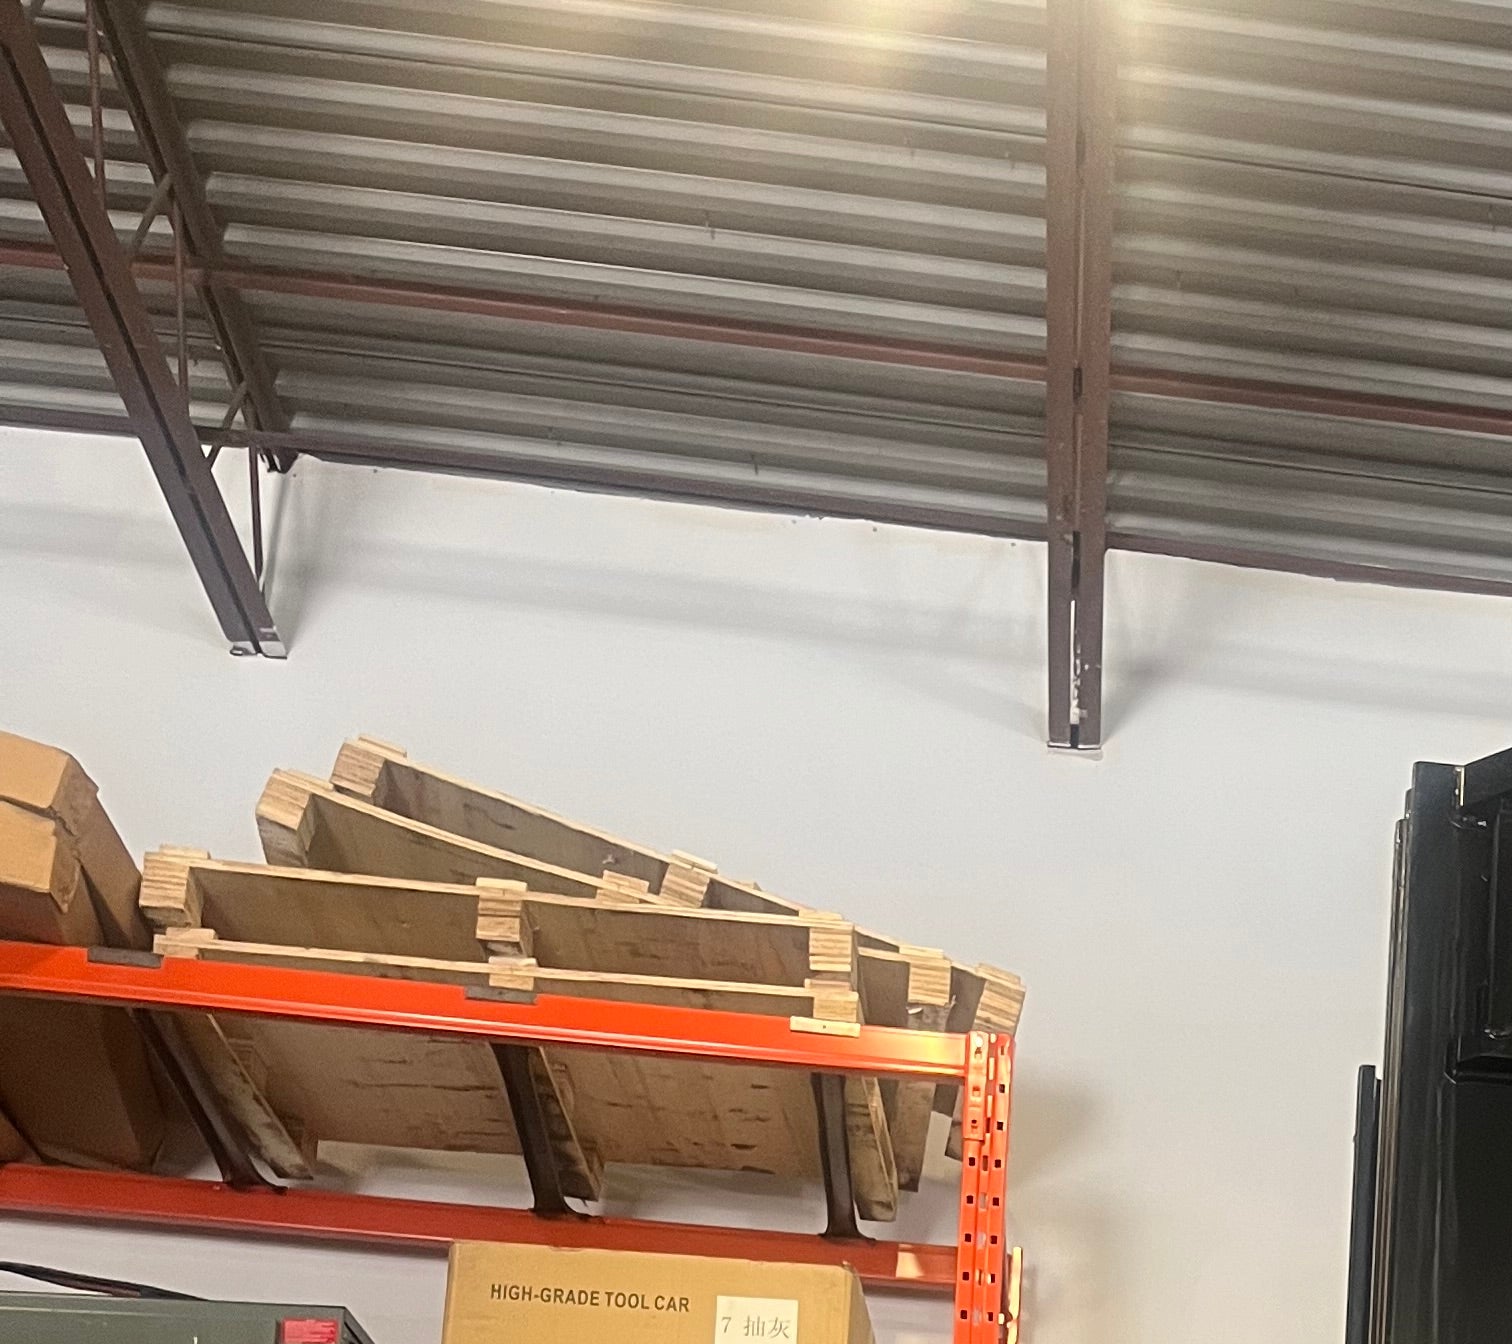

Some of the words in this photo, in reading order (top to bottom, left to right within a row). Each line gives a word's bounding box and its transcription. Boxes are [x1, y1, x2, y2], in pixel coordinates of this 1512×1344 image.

[490, 1283, 600, 1306] HIGH-GRADE
[604, 1292, 650, 1310] TOOL
[654, 1296, 690, 1312] CAR
[721, 1317, 732, 1334] 7
[744, 1316, 790, 1339] 抽灰
